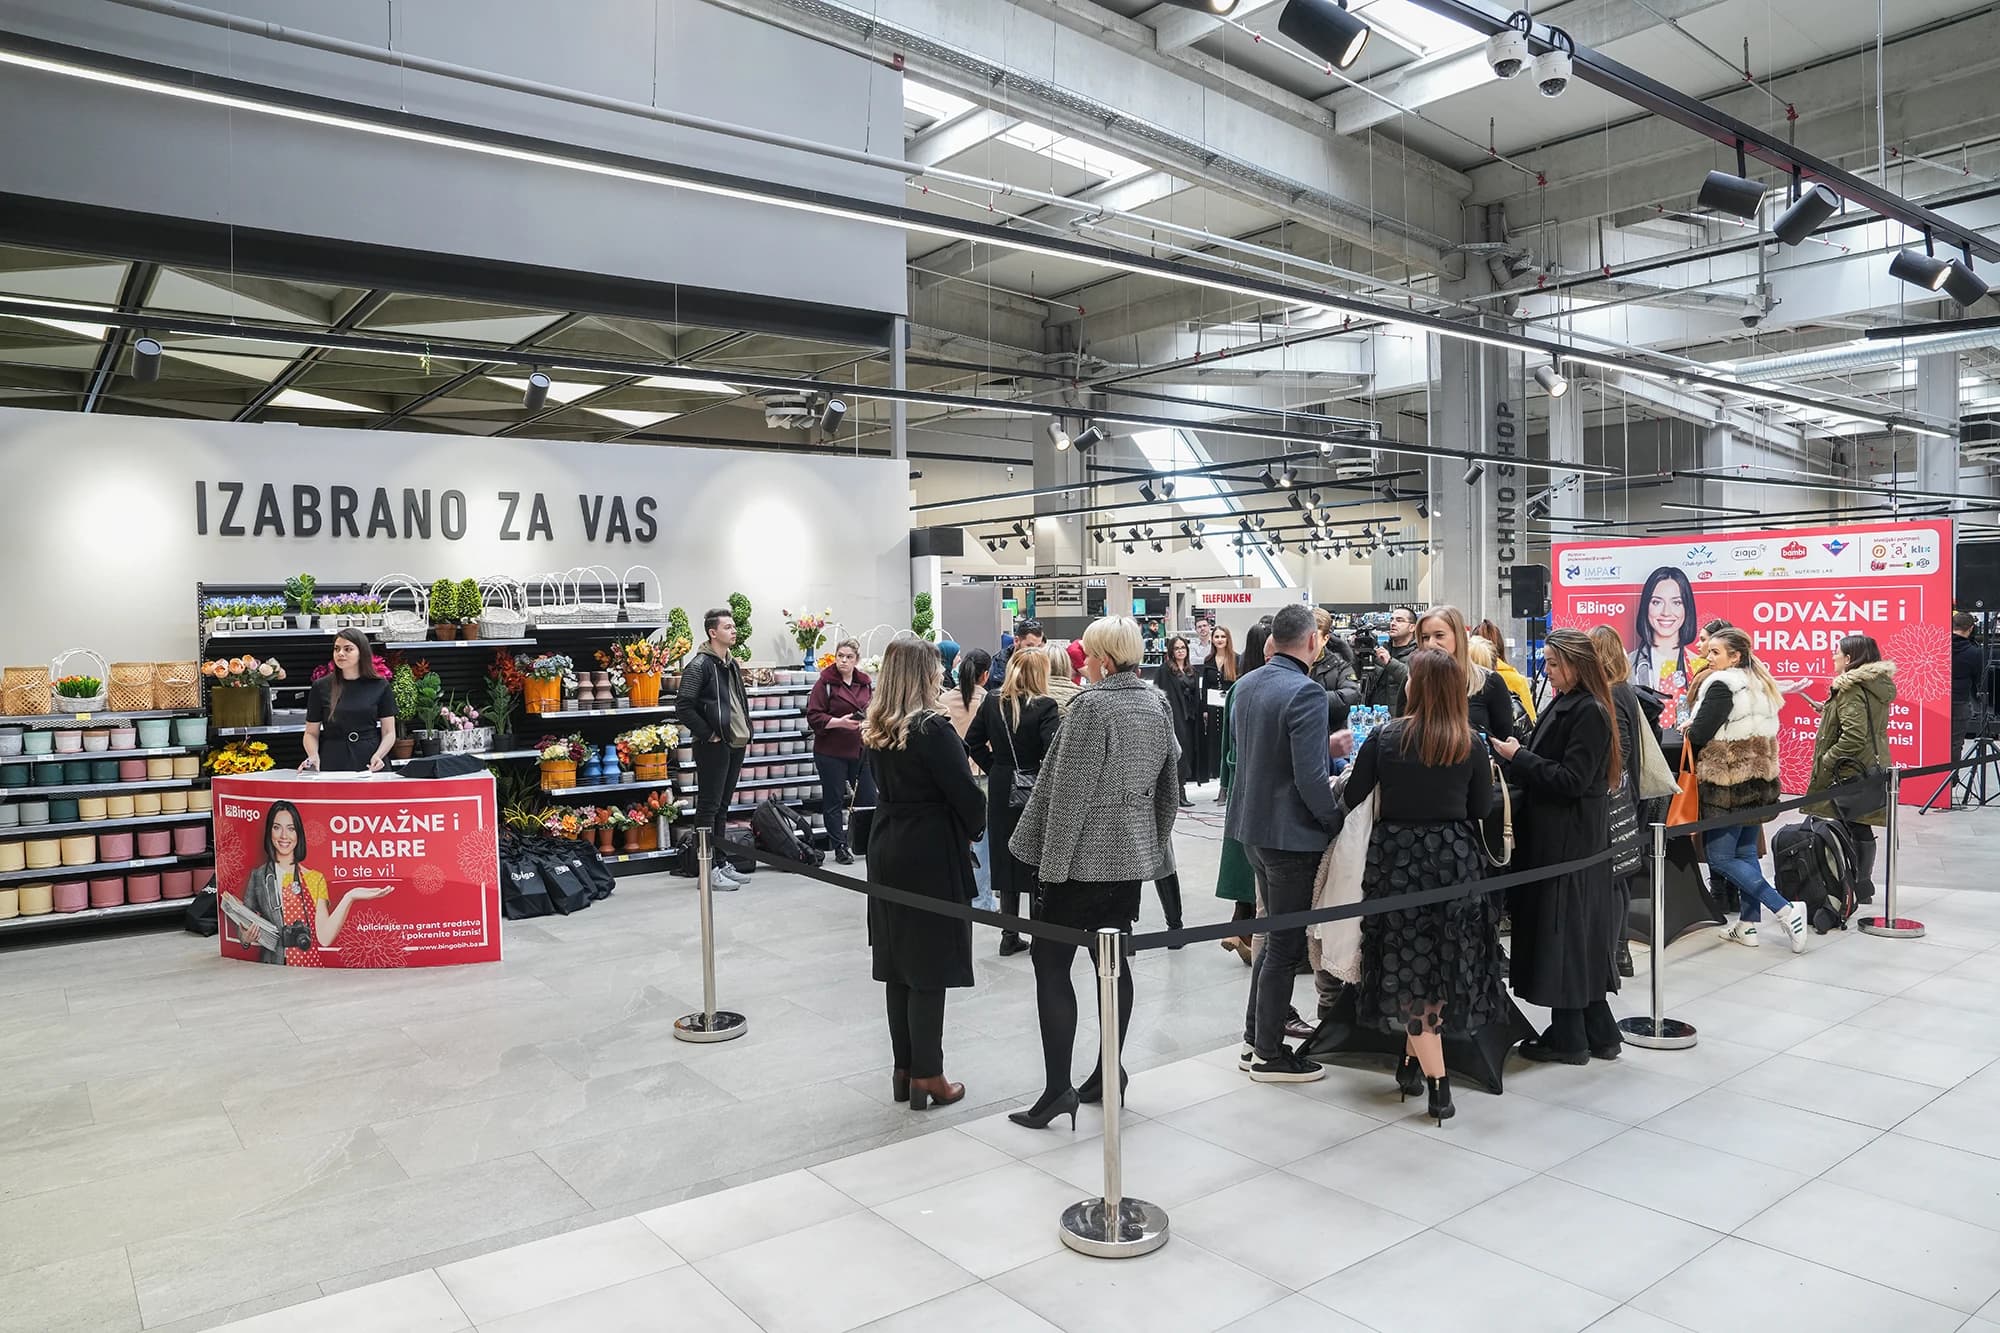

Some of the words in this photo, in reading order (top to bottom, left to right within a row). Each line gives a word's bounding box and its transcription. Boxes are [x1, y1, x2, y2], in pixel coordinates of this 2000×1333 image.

[1497, 401, 1516, 478] SHOP
[195, 480, 467, 541] IZABRANO
[498, 491, 554, 541] ZA
[579, 493, 658, 543] VAS
[1497, 487, 1516, 599] TECHNO
[1782, 548, 1806, 557] bambi
[1384, 578, 1408, 592] ALATI
[1202, 593, 1252, 604] TELEFUNKEN
[1588, 601, 1625, 616] Bingo
[1752, 593, 1888, 623] ODVAŽNE
[1898, 599, 1906, 622] i
[1776, 659, 1800, 673] ste
[1806, 658, 1826, 673] vi!
[1794, 716, 1811, 725] na
[1887, 719, 1913, 730] stva
[1888, 734, 1913, 746] nis!
[231, 804, 260, 822] Bingo
[329, 809, 445, 835] ODVAŽNE
[453, 812, 460, 831] i
[331, 838, 426, 859] HRABRE
[333, 865, 348, 878] to
[352, 864, 373, 878] ste
[377, 863, 395, 877] vi!
[357, 922, 401, 932] Aplicirajte
[416, 921, 441, 931] grant
[442, 919, 481, 928] sredstva
[401, 931, 405, 939] i
[406, 930, 451, 941] pokrenite
[452, 927, 481, 937] biznis!
[419, 942, 478, 951] www.bingobih.ba
